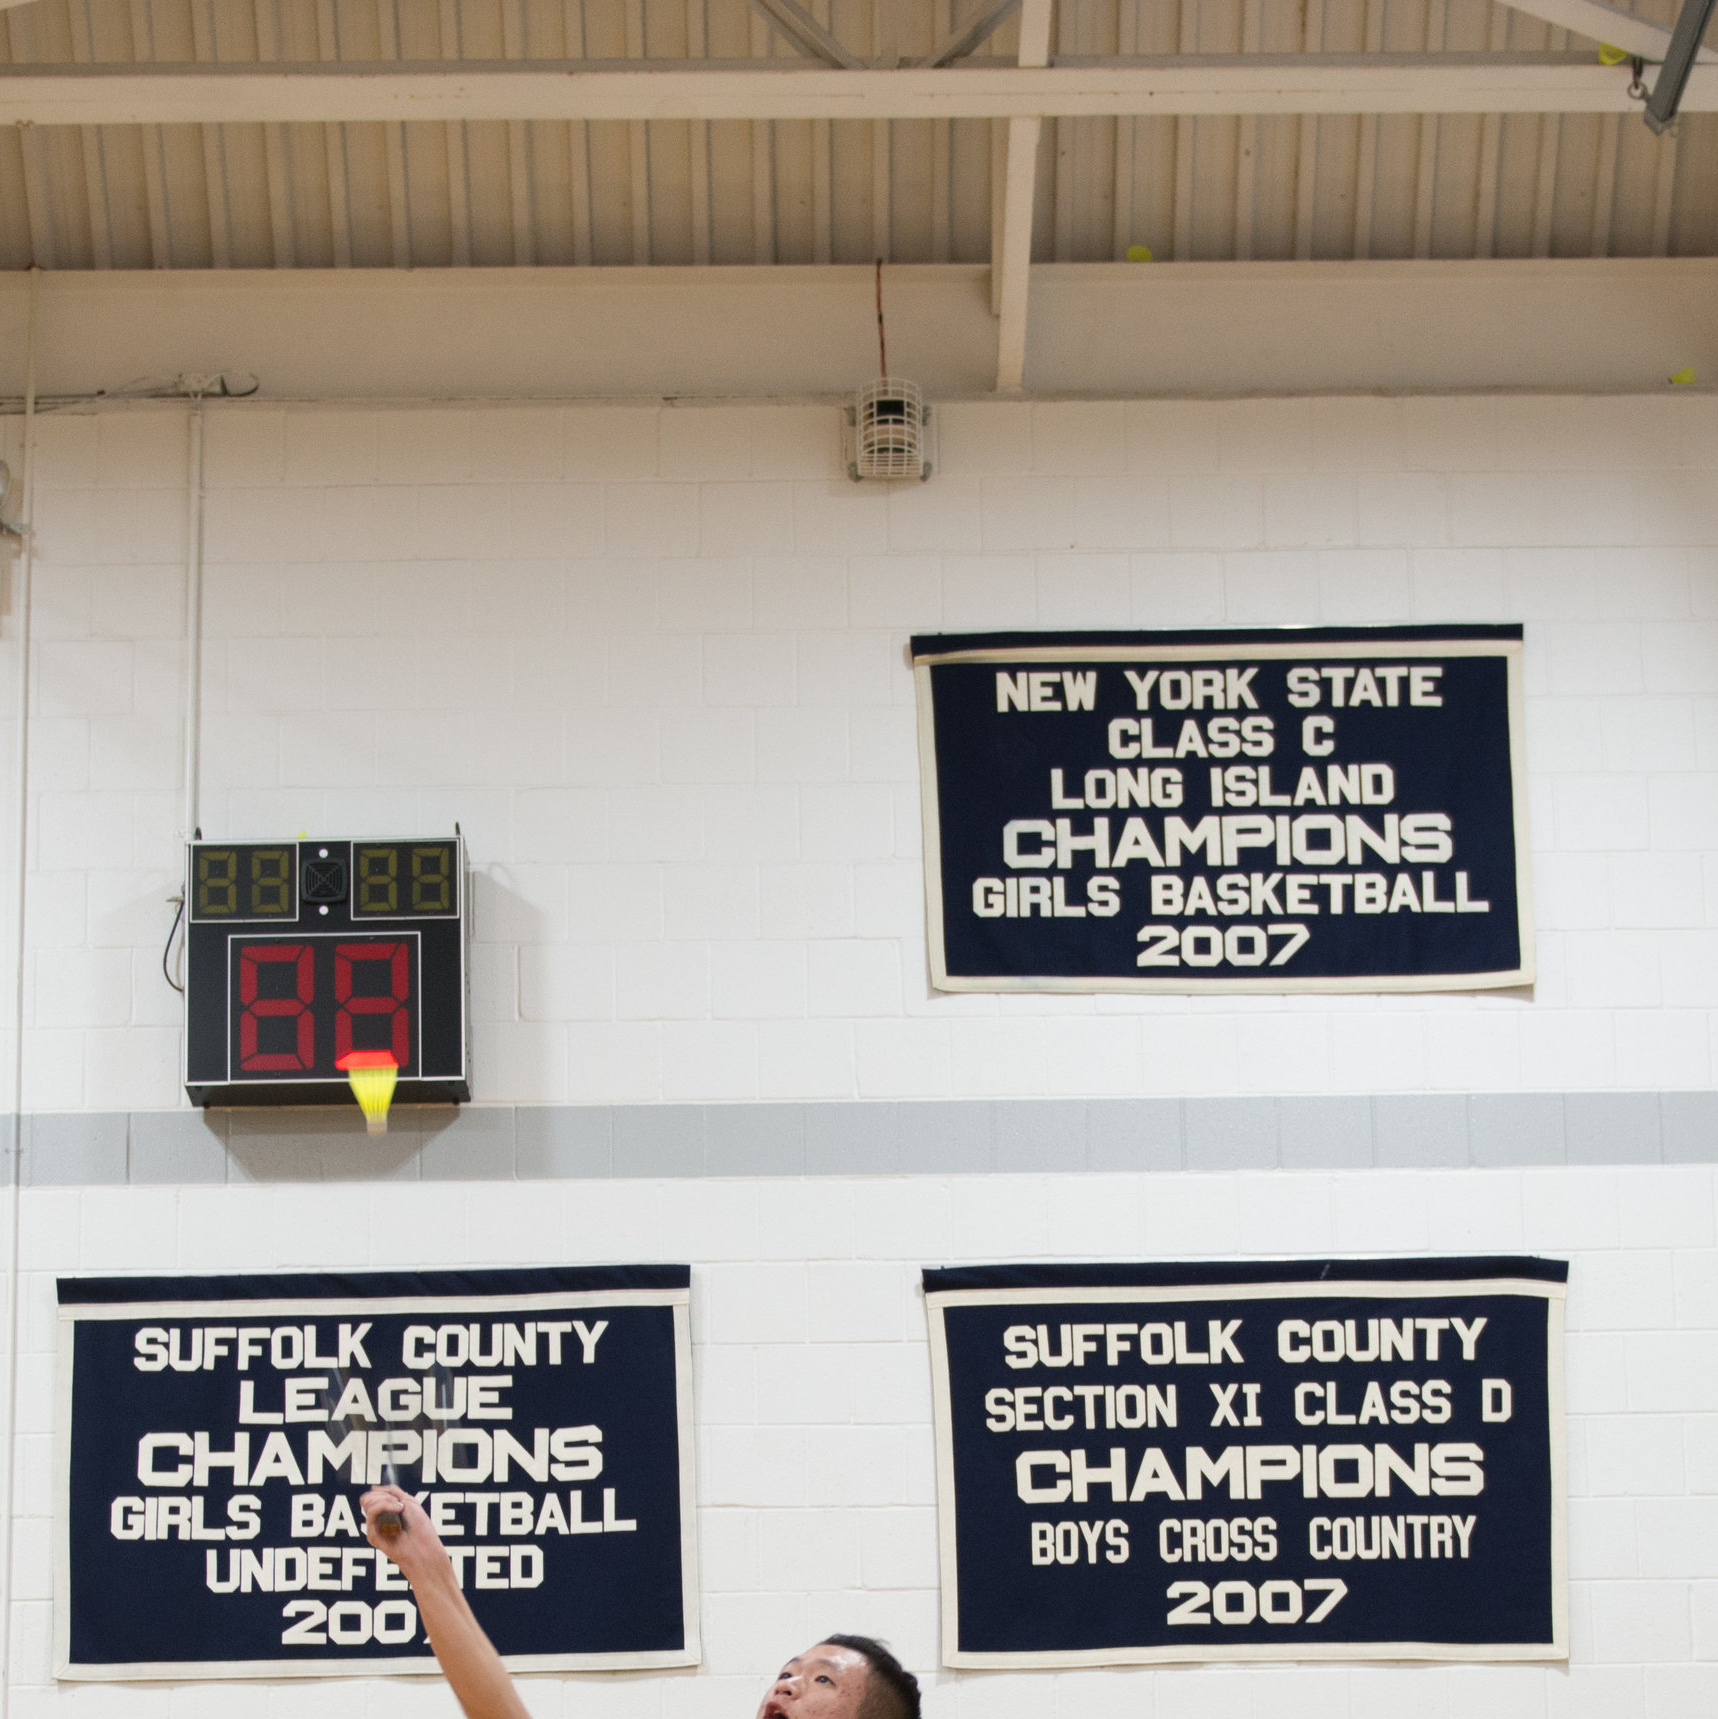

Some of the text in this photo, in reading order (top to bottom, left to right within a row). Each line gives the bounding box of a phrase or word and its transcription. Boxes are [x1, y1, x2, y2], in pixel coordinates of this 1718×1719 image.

[996, 667, 1442, 712] NEW YORK STATE
[1108, 716, 1334, 759] CLASS C
[1051, 764, 1394, 809] LONG ISLAND
[1004, 813, 1452, 868] CHAMPIONS
[973, 871, 1489, 917] GIRLS BASKETBALL
[1137, 924, 1310, 966] 2007
[134, 1321, 608, 1371] SUFFOLK COUNTY
[1004, 1318, 1487, 1369] SUFFOLK COUNTY
[239, 1375, 512, 1424] LEAGUE
[985, 1379, 1511, 1432] SECTION XI CLASS D
[138, 1425, 602, 1494] CHAMPIONS
[1016, 1443, 1484, 1503] CHAMPIONS
[111, 1488, 637, 1540] GIRLS BAETBALL
[1032, 1515, 1476, 1565] BOYS CROSS COUNTRY
[206, 1544, 544, 1593] UNDEFETED
[282, 1598, 434, 1646] 200
[1167, 1579, 1347, 1625] 2007
